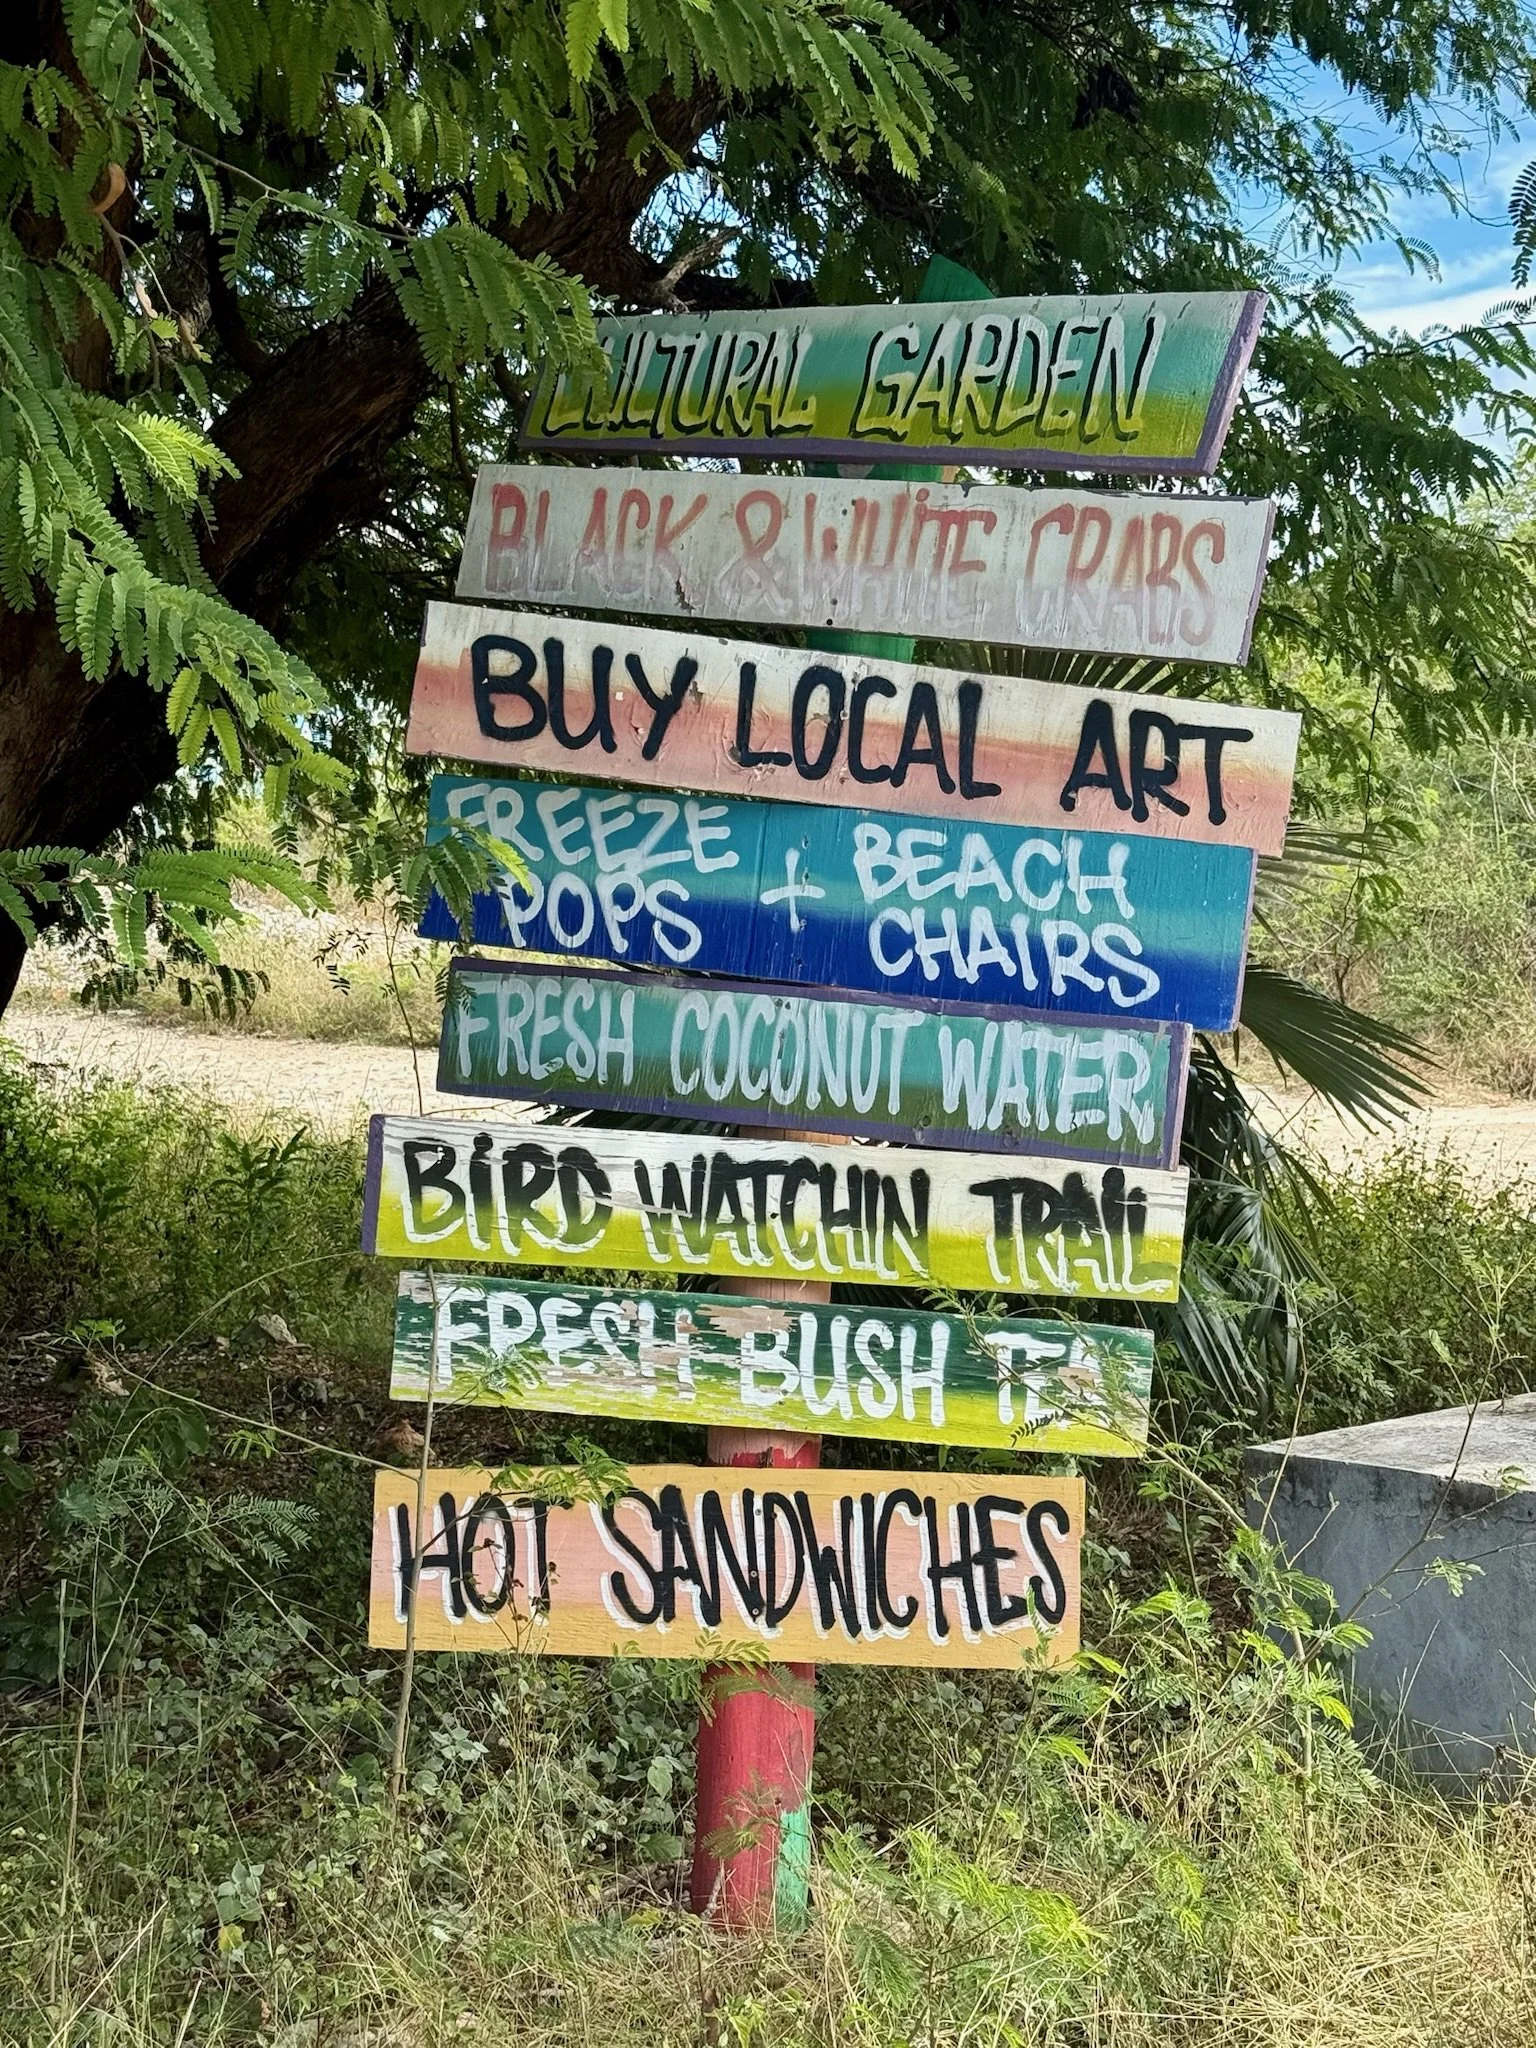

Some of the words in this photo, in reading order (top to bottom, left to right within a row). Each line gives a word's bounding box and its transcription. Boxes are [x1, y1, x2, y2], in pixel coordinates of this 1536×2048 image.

[849, 312, 1162, 444] GARDEN
[486, 482, 710, 606] BLACK
[1016, 501, 1226, 648] CRABS
[470, 634, 698, 760] BUY
[735, 660, 1002, 800] LOCAL
[1060, 699, 1254, 824] ART
[446, 783, 740, 873] FREEZE
[852, 822, 1136, 920] BEACH
[499, 870, 702, 964] POPS
[868, 905, 1162, 1008] CHAIRS
[452, 978, 636, 1086] FRESH
[670, 990, 922, 1116] COCONUT
[938, 1024, 1156, 1146] WATER
[635, 1150, 930, 1280] WATCHIN
[436, 1284, 698, 1400] FRESH
[738, 1310, 950, 1428] BUSH
[389, 1488, 574, 1628] HOT
[592, 1483, 1070, 1646] SANDWICHES
